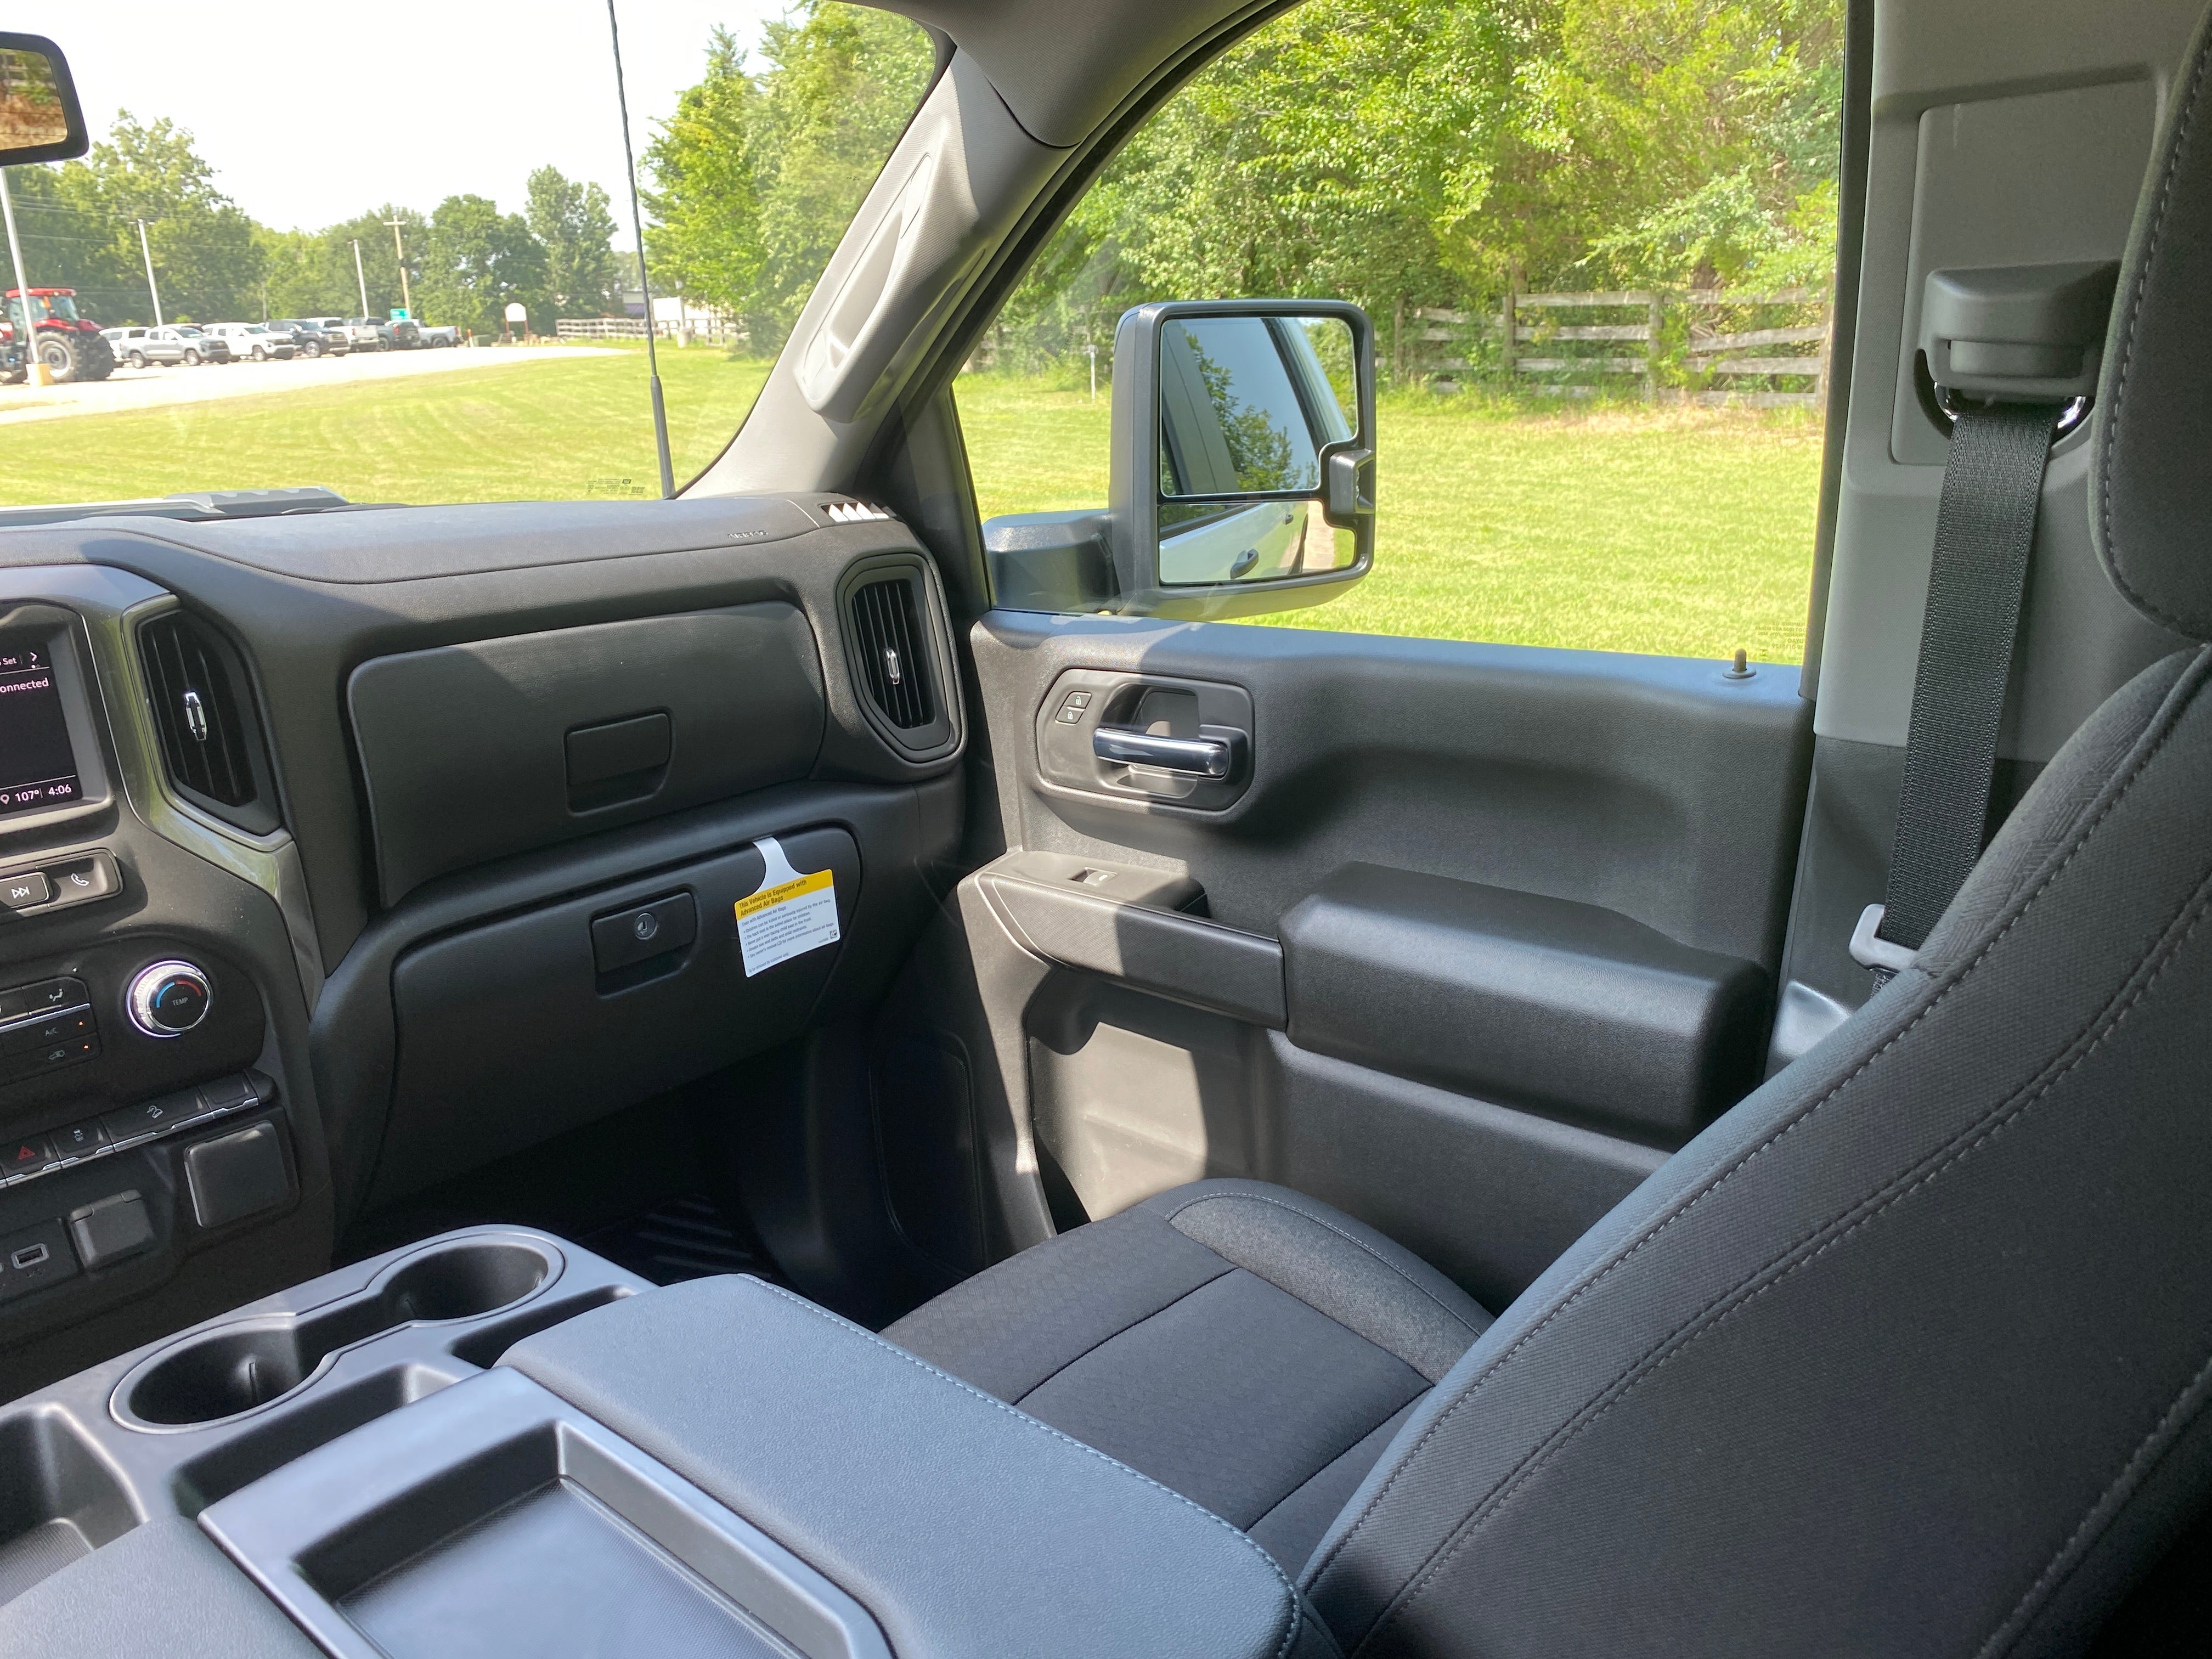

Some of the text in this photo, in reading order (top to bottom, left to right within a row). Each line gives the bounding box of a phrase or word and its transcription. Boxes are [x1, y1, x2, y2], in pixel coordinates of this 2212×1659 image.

[48, 784, 72, 795] 4:06
[739, 901, 748, 909] This
[749, 894, 766, 905] Vehicle
[772, 883, 794, 896] Equipped
[795, 879, 806, 888] with
[740, 902, 762, 916] Advanced
[771, 894, 783, 905] Bags
[757, 910, 771, 920] Advanced
[172, 997, 188, 1006] TEMP
[44, 1027, 58, 1036] A/C
